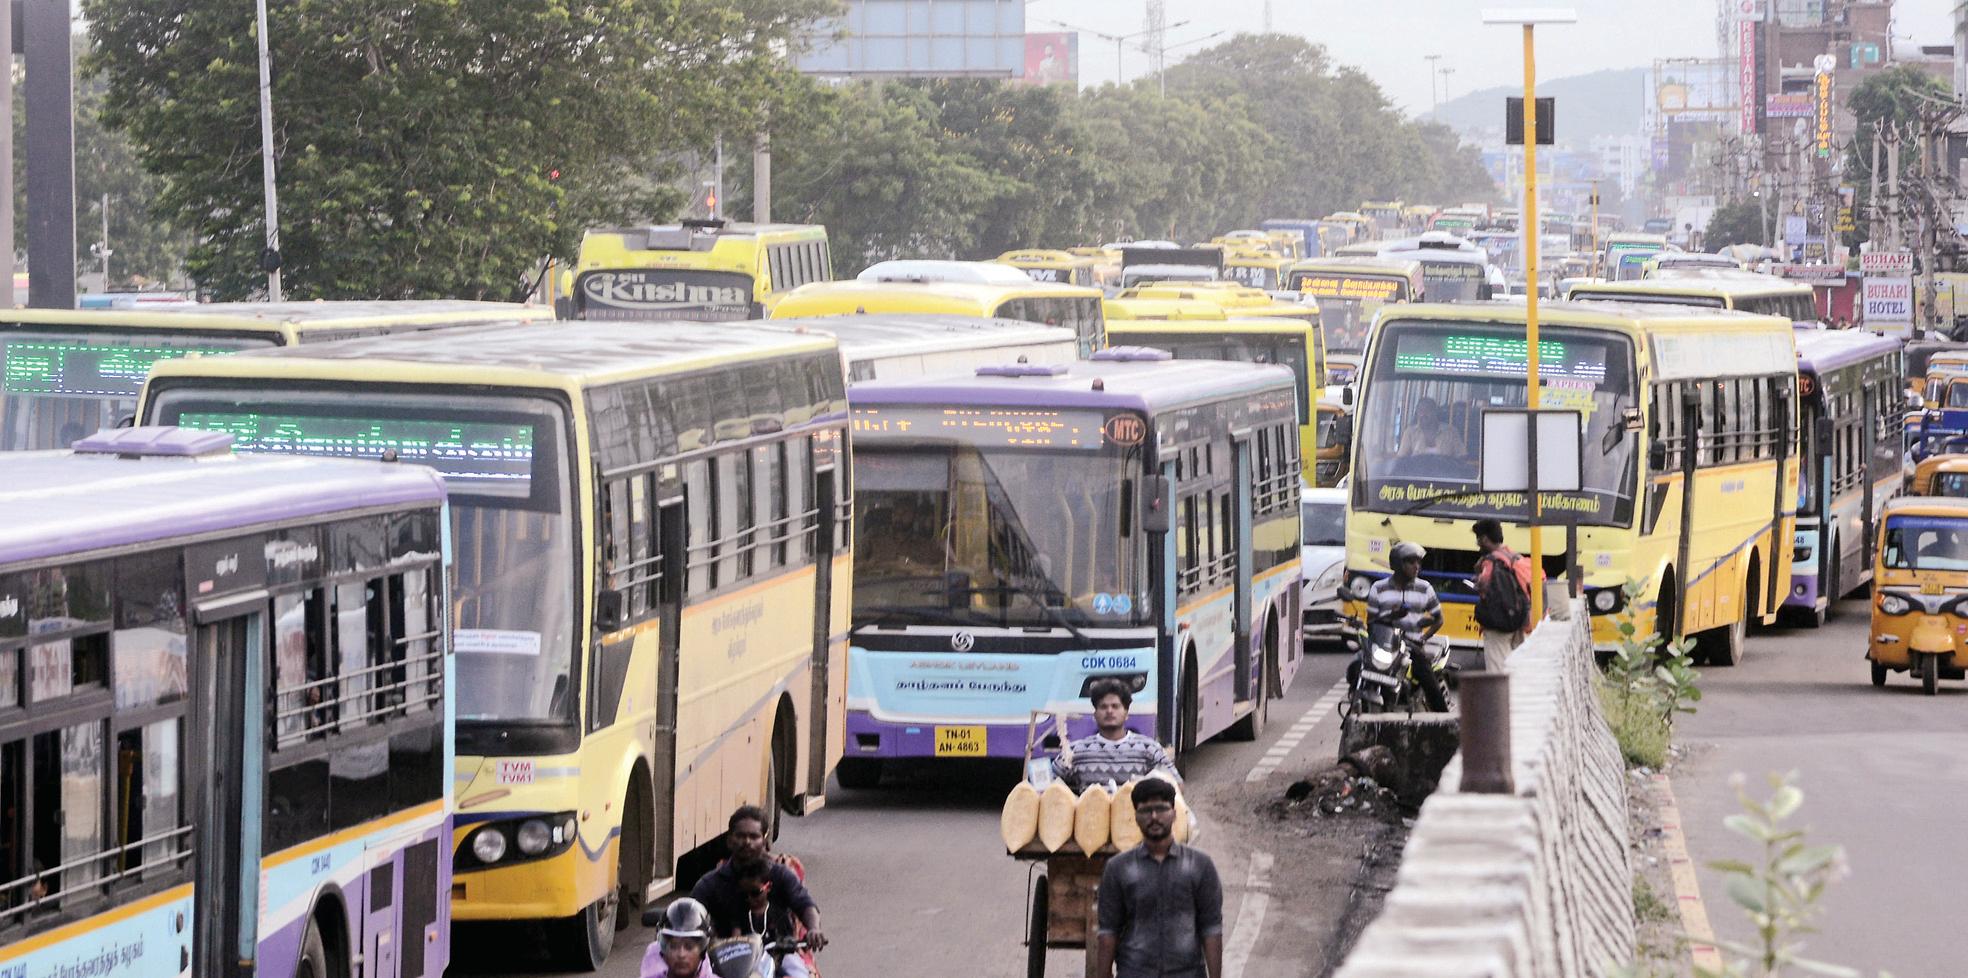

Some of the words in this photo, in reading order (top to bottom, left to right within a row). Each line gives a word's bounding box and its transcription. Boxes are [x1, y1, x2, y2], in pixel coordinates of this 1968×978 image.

[1863, 255, 1911, 264] BUHARI
[1867, 284, 1908, 298] BUHARI
[1869, 301, 1906, 314] HOTEL
[1114, 419, 1139, 441] MTC
[1081, 657, 1105, 668] CDK
[1108, 656, 1136, 668] 0684
[945, 729, 971, 740] TN-01
[502, 761, 531, 771] TVM
[502, 774, 531, 783] TVM1
